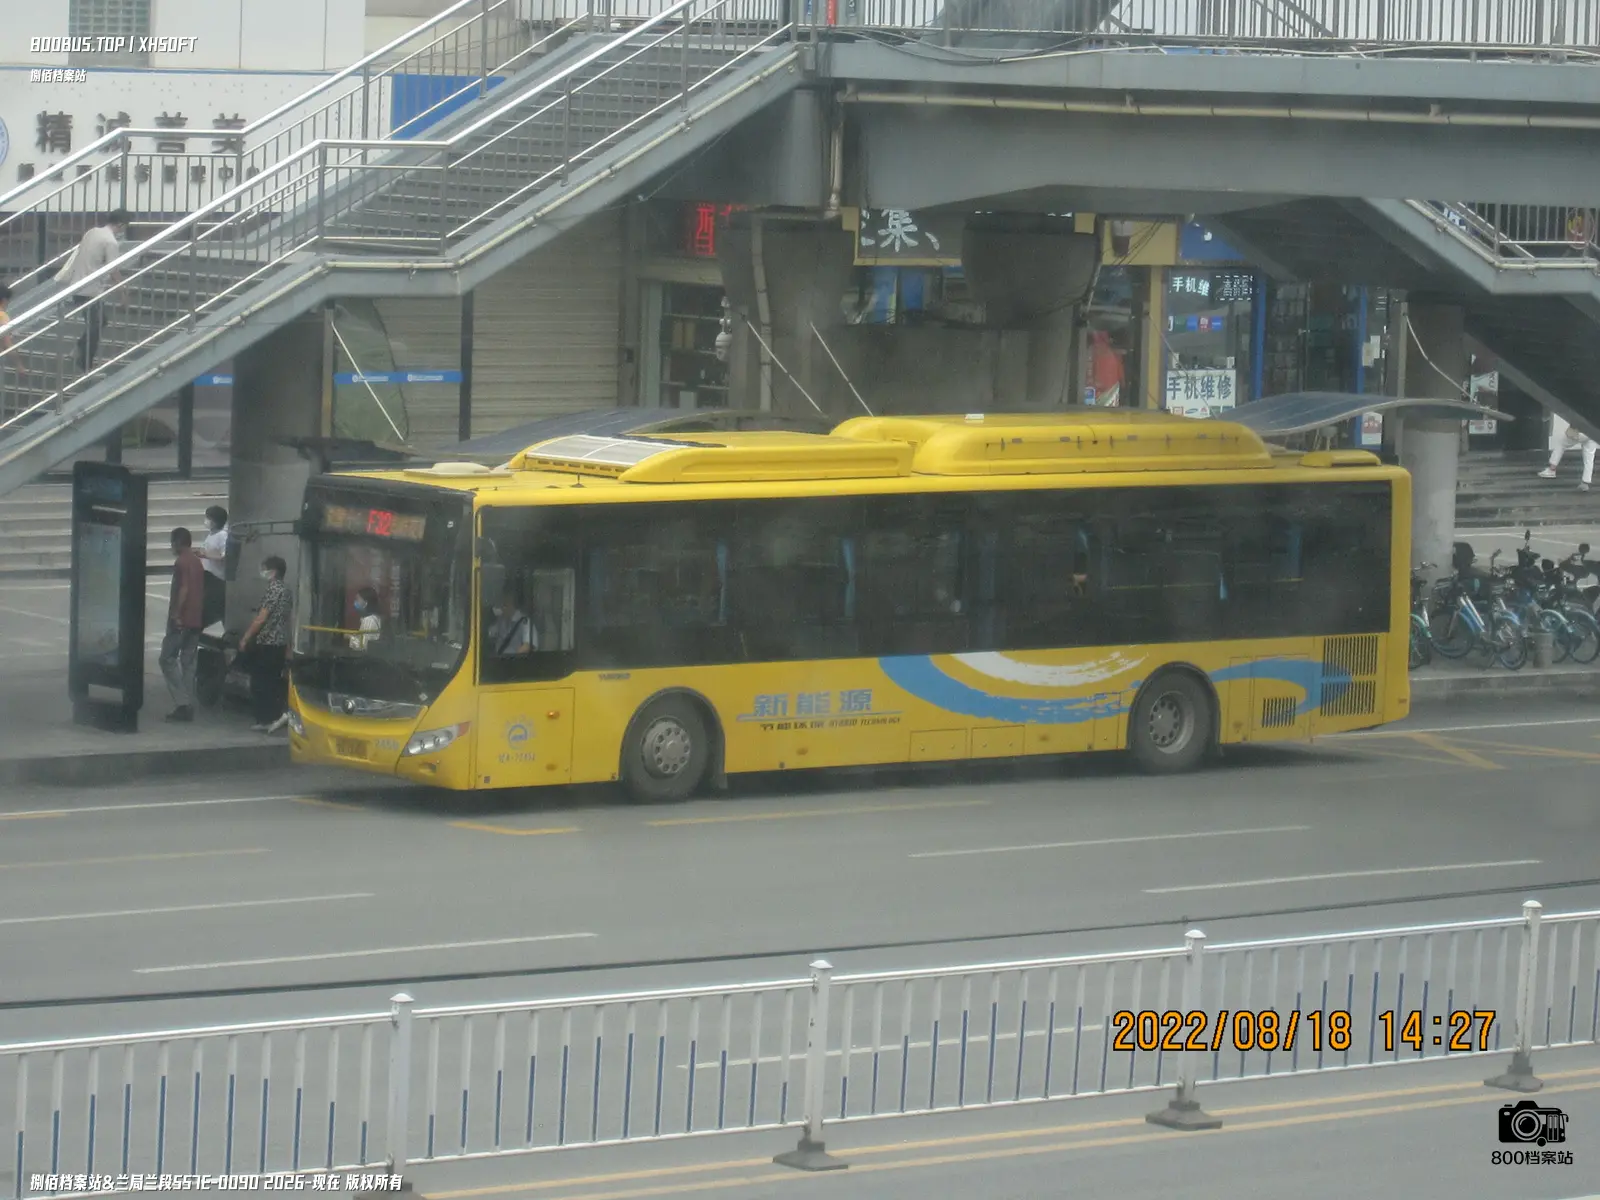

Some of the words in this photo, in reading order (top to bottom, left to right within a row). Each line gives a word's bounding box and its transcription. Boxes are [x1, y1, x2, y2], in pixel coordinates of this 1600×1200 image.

[1166, 374, 1232, 400] 手机维修
[754, 688, 873, 716] 新能源
